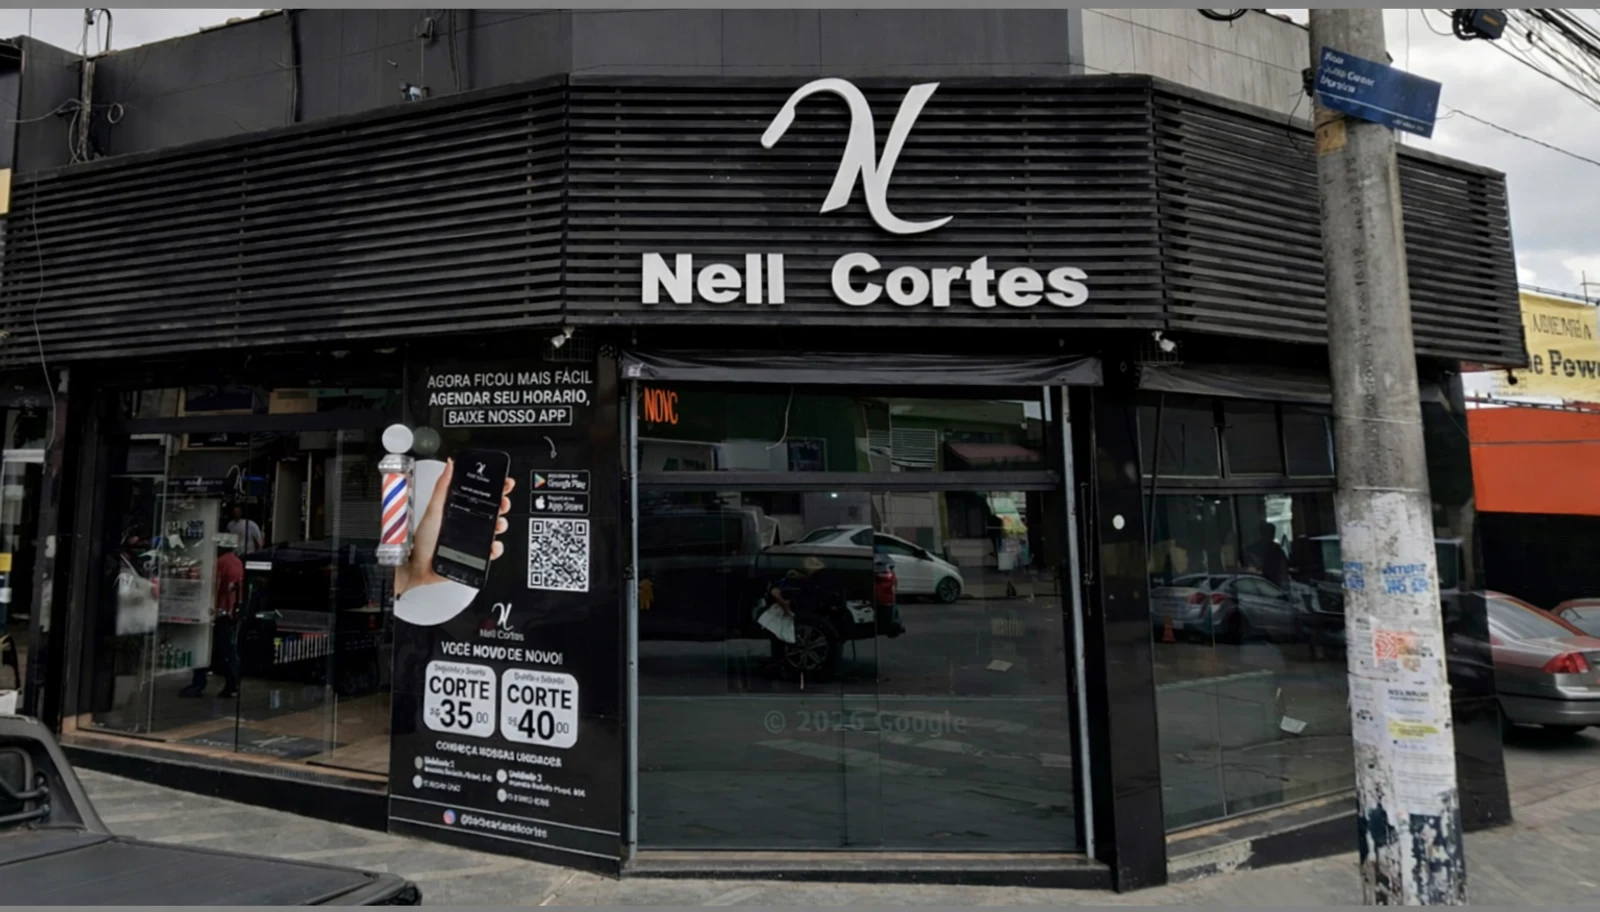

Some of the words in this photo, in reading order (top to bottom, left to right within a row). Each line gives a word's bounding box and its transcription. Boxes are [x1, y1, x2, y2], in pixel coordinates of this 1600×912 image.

[642, 252, 784, 305] Nell
[831, 252, 1089, 308] Cortes
[1548, 350, 1600, 379] Pow
[427, 374, 470, 388] AGORA
[474, 372, 514, 386] FICOU
[518, 370, 550, 386] MAIS
[554, 367, 592, 384] FÁCIL
[428, 392, 490, 406] AGENDAR
[493, 391, 520, 404] SEU
[523, 388, 590, 406] HORÁRIO,
[448, 410, 484, 424] BAIXE
[488, 410, 536, 424] NOSSO
[538, 409, 566, 423] APP
[473, 644, 506, 660] NOVO
[508, 647, 522, 660] DE
[430, 676, 490, 700] CORTE
[507, 684, 572, 709] CORTE
[440, 699, 472, 730] 35
[518, 709, 555, 740] 40
